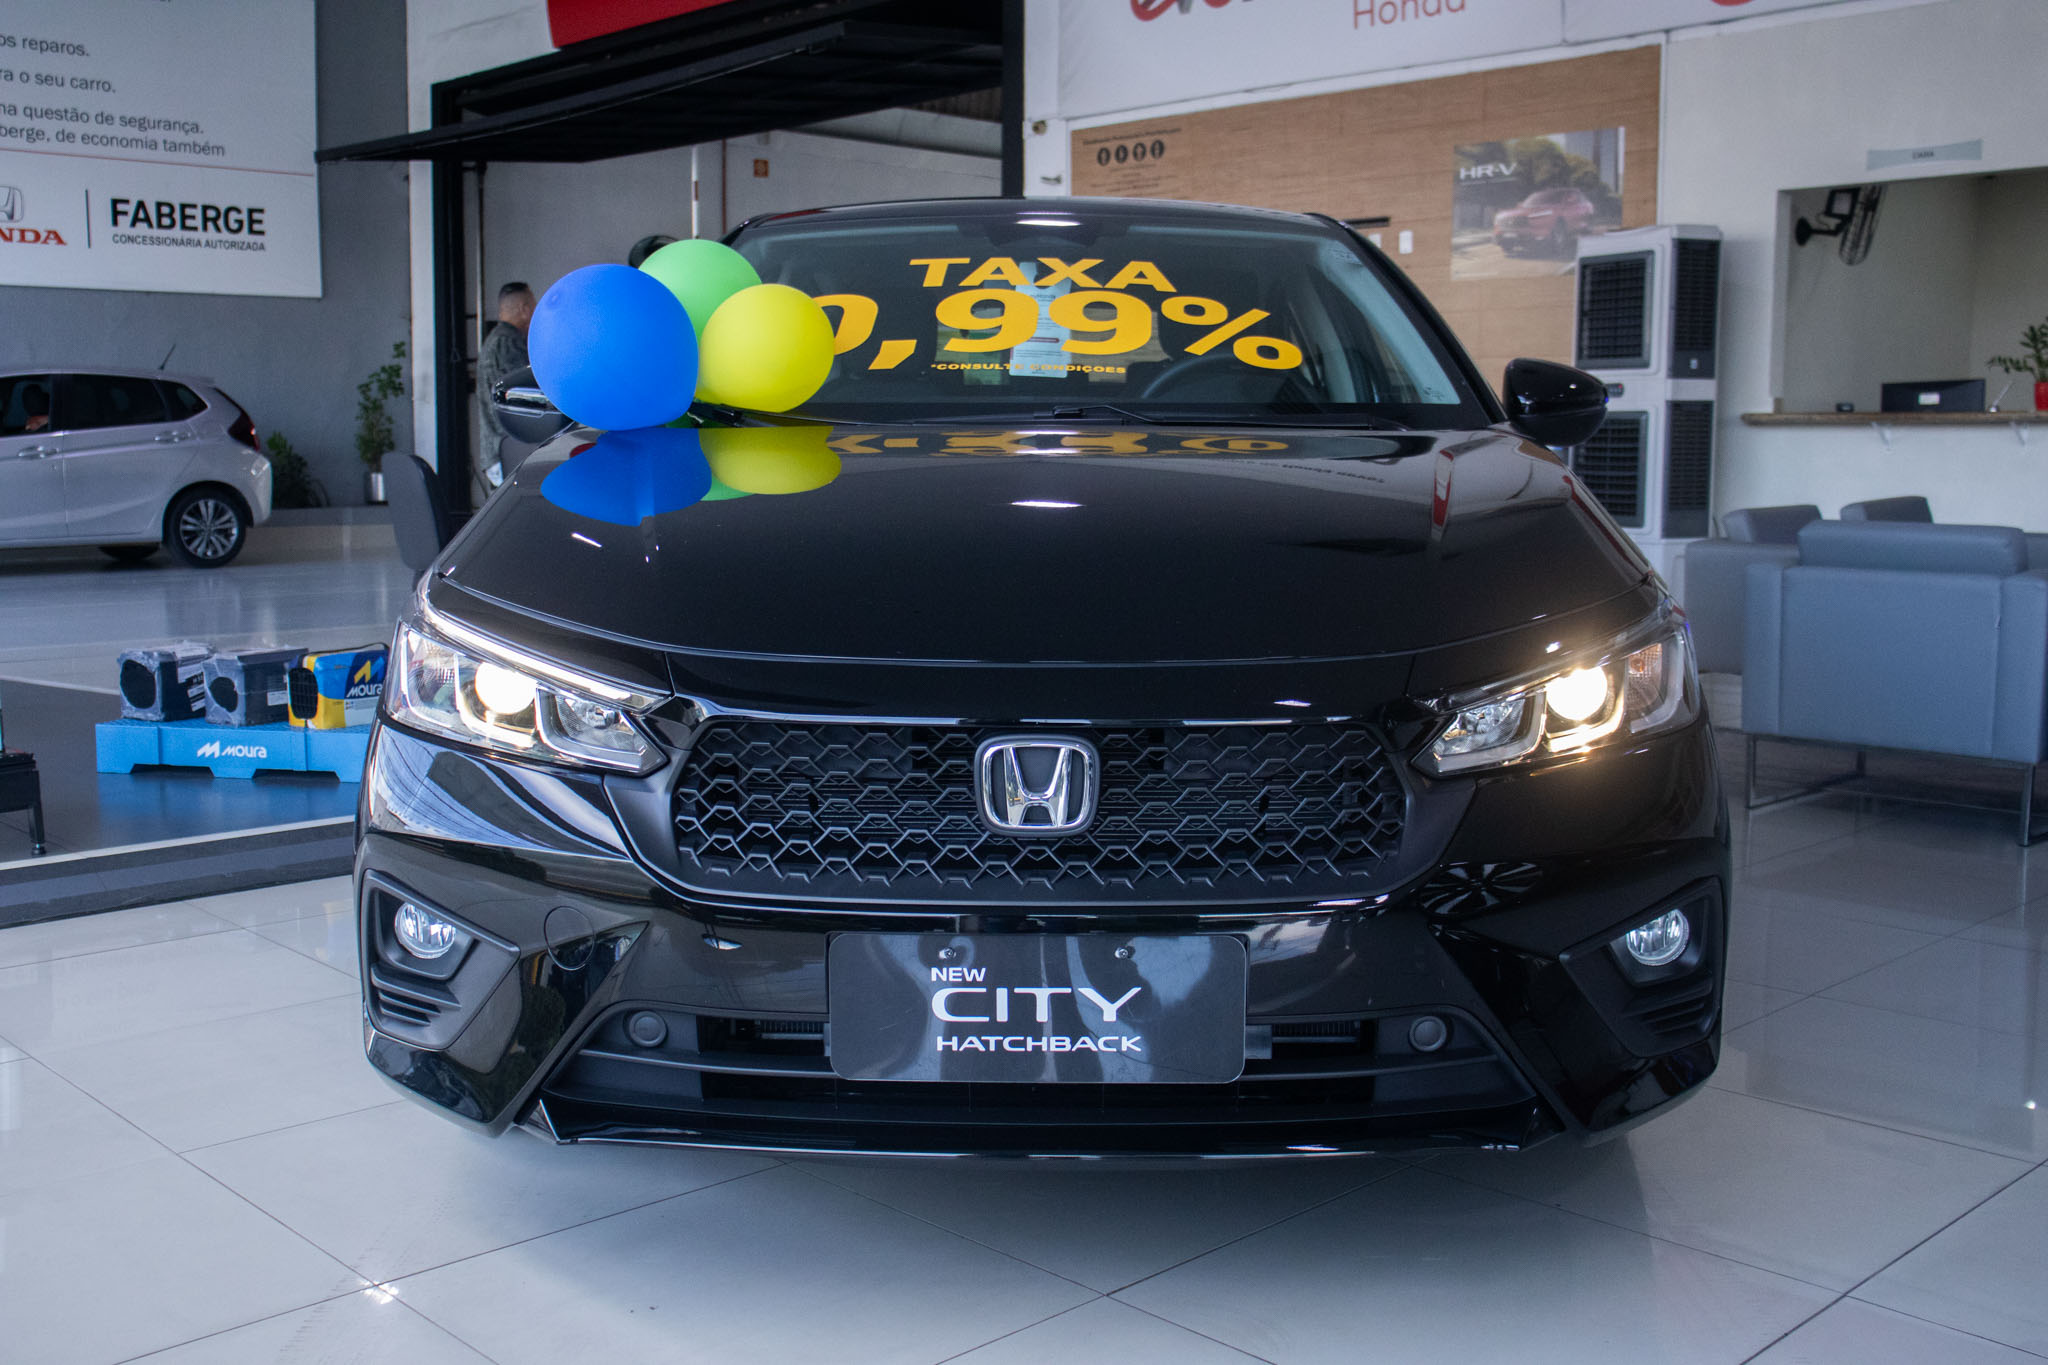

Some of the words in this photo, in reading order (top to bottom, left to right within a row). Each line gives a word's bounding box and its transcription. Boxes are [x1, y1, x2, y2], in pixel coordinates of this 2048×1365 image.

[22, 37, 90, 57] reparos.
[0, 68, 14, 82] a
[20, 71, 30, 84] o
[35, 73, 64, 88] seu
[70, 77, 116, 93] carro.
[23, 105, 90, 124] questão
[94, 111, 115, 126] de
[119, 116, 204, 136] segurança.
[55, 128, 76, 143] de
[81, 133, 158, 151] economia
[162, 138, 226, 157] também
[1460, 162, 1517, 180] HR-V
[110, 198, 265, 236] FABERGE
[112, 234, 201, 248] CONCESSIONÁRIA
[204, 239, 266, 252] AUTORIZADA
[909, 257, 1177, 292] TAXA
[812, 289, 1303, 370] 0,99%
[931, 967, 986, 982] NEW
[932, 987, 1142, 1022] CITY
[936, 1036, 1142, 1052] HATCHBACK
